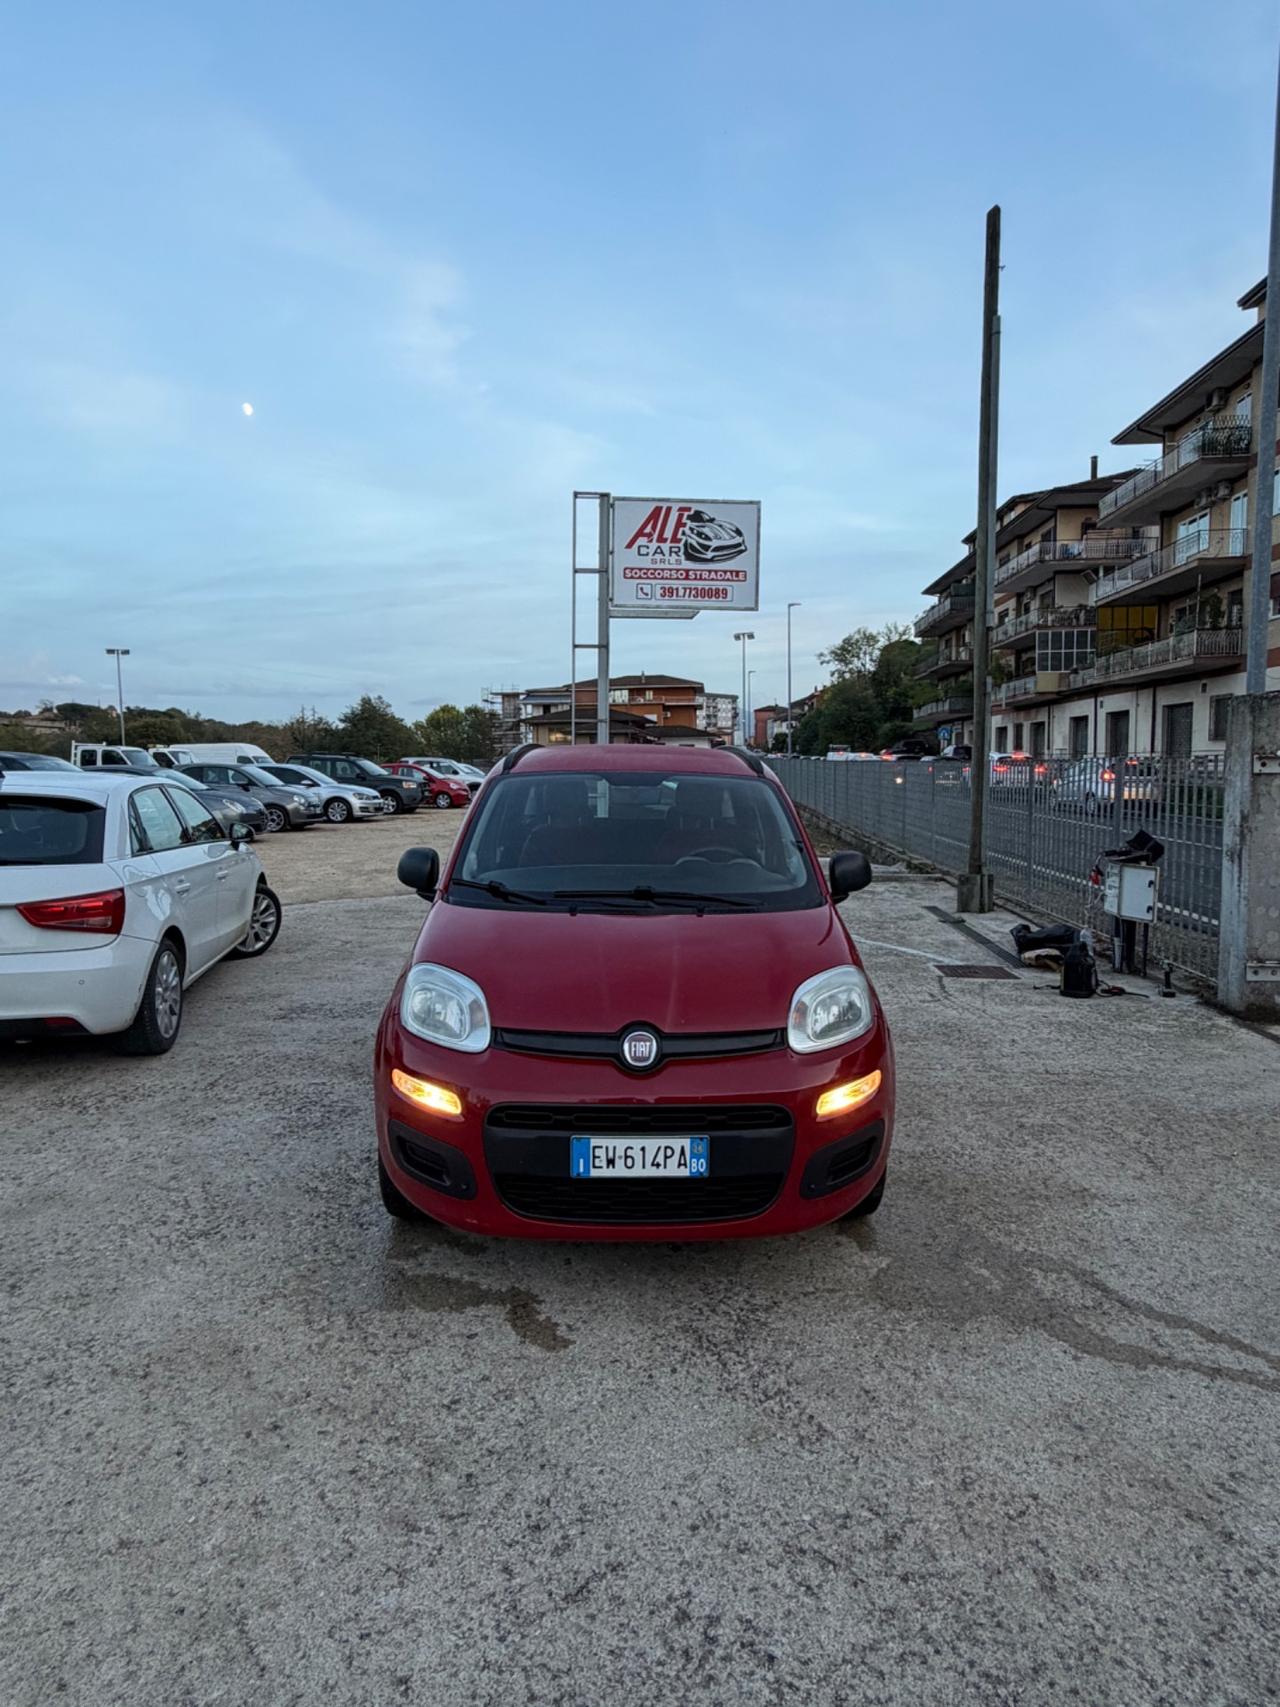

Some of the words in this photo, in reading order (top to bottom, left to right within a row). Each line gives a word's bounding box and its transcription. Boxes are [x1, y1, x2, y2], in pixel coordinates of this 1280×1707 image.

[624, 505, 692, 549] ALE
[637, 545, 681, 557] CAR
[625, 568, 686, 579] SOCCORSO
[688, 570, 745, 580] STRADALE
[631, 1041, 651, 1057] FIAT
